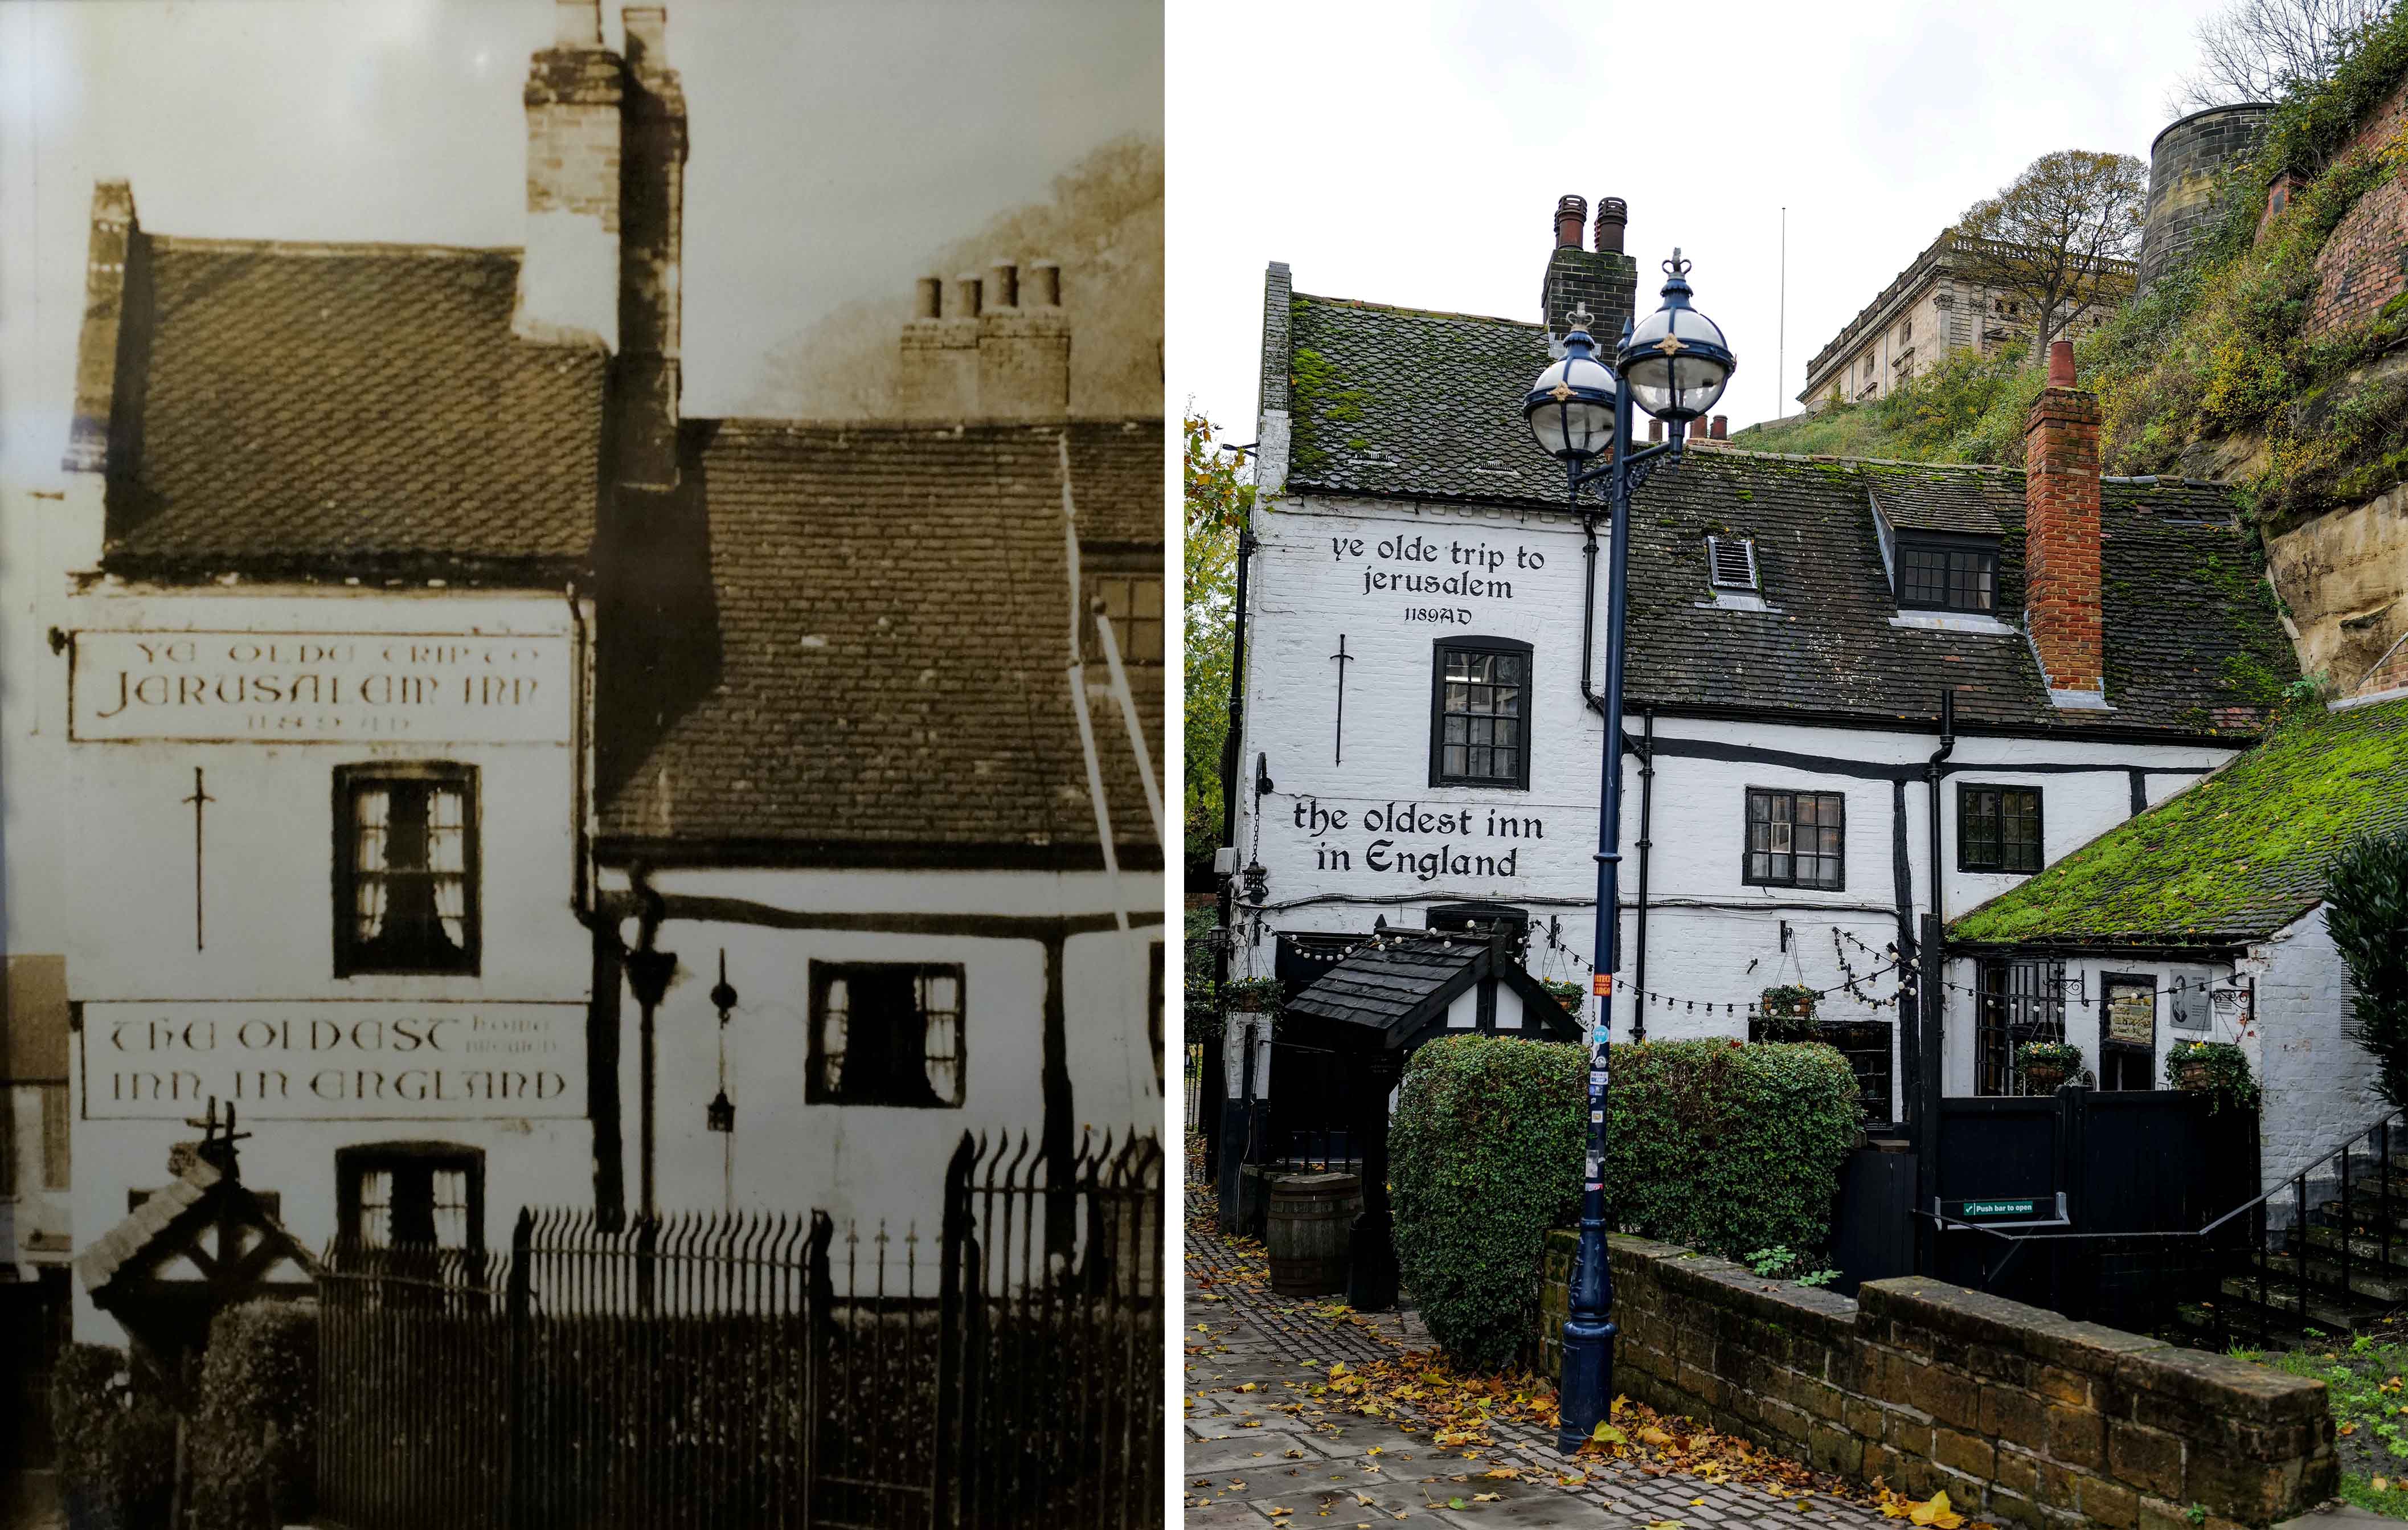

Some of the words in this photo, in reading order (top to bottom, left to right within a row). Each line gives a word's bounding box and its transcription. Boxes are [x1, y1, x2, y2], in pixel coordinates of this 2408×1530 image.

[1332, 537, 1364, 562] ye
[1377, 534, 1438, 562] olde
[1451, 541, 1504, 573] trip
[1517, 545, 1545, 570] to
[1363, 566, 1513, 599] jerusalem
[1404, 607, 1472, 625] 1189AD
[1293, 799, 1348, 837] the
[1364, 801, 1472, 836] oldest
[1486, 808, 1544, 840] inn
[1317, 841, 1352, 872] in
[1367, 839, 1518, 882] England
